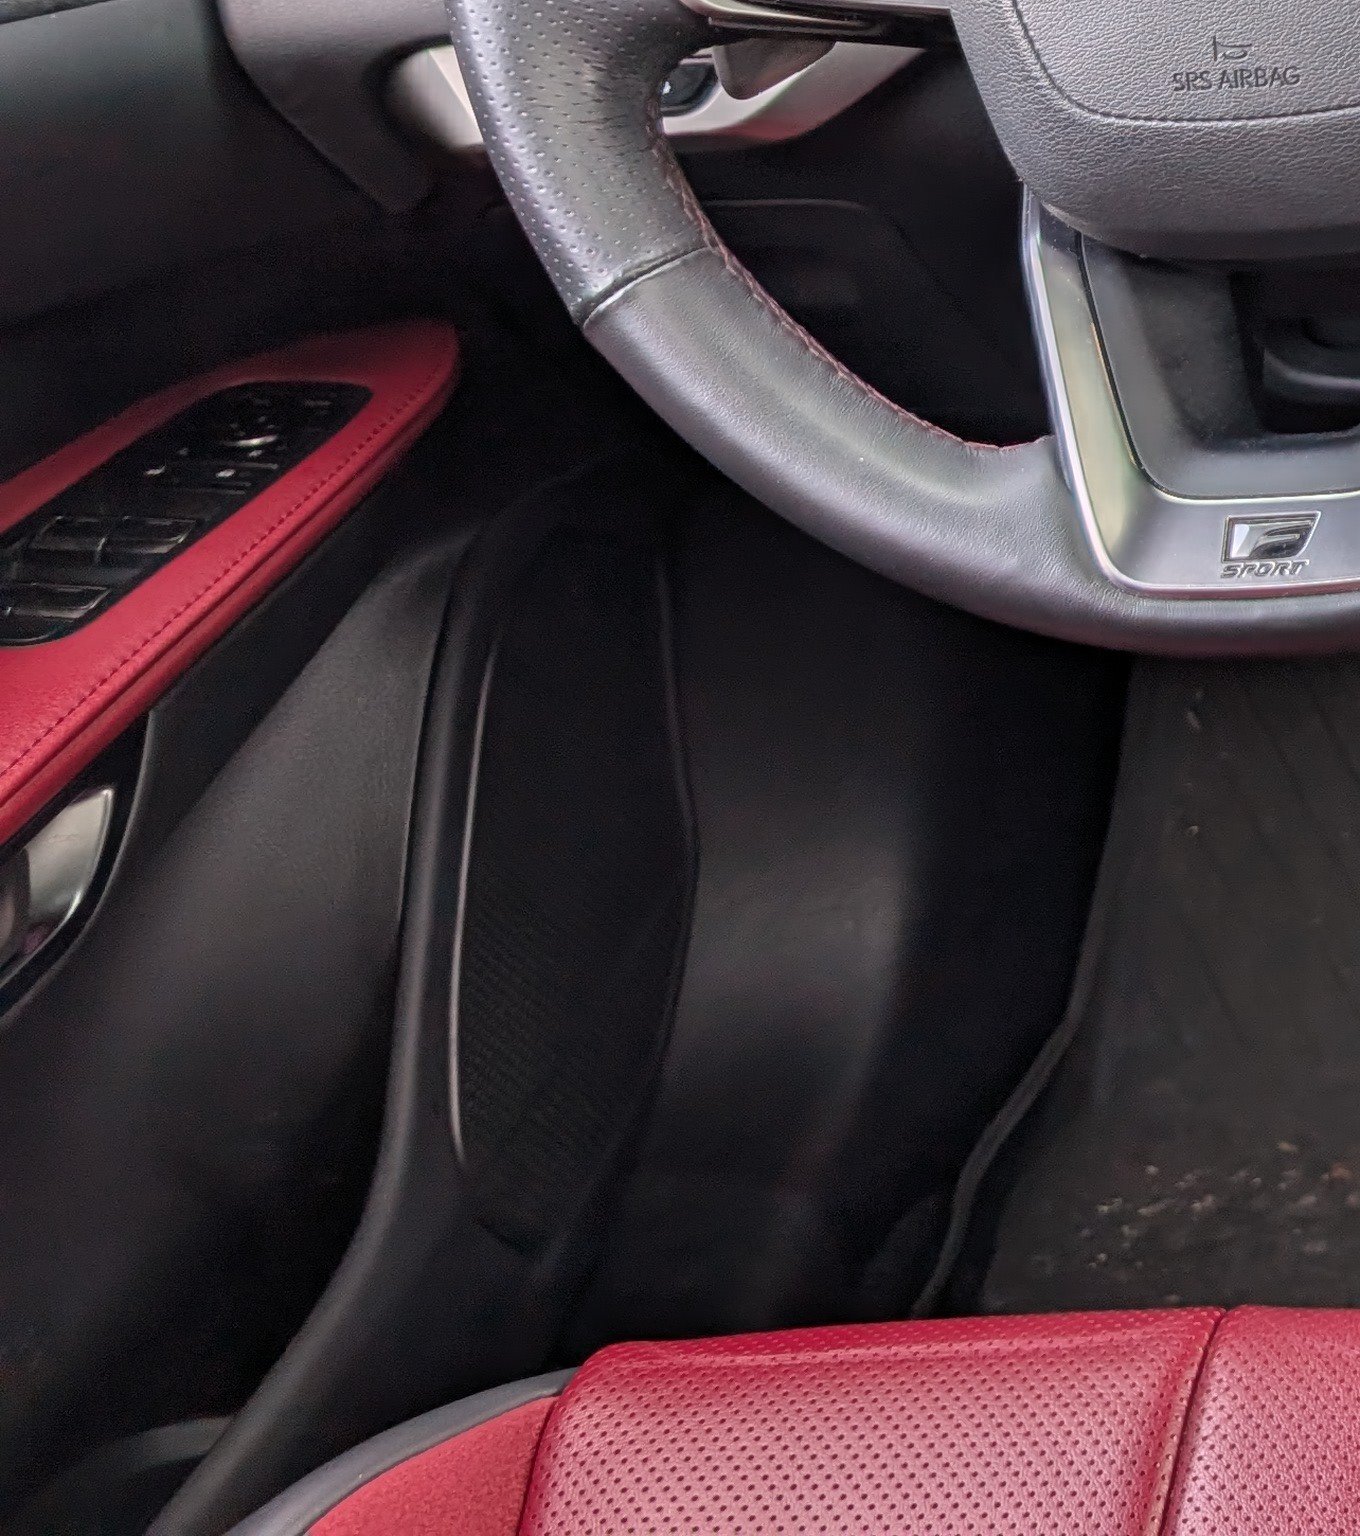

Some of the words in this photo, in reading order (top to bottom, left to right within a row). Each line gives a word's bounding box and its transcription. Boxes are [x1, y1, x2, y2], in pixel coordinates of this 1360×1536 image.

[1172, 70, 1213, 92] SRS
[1218, 69, 1301, 91] AIRBAG
[1220, 559, 1310, 579] SPORT
